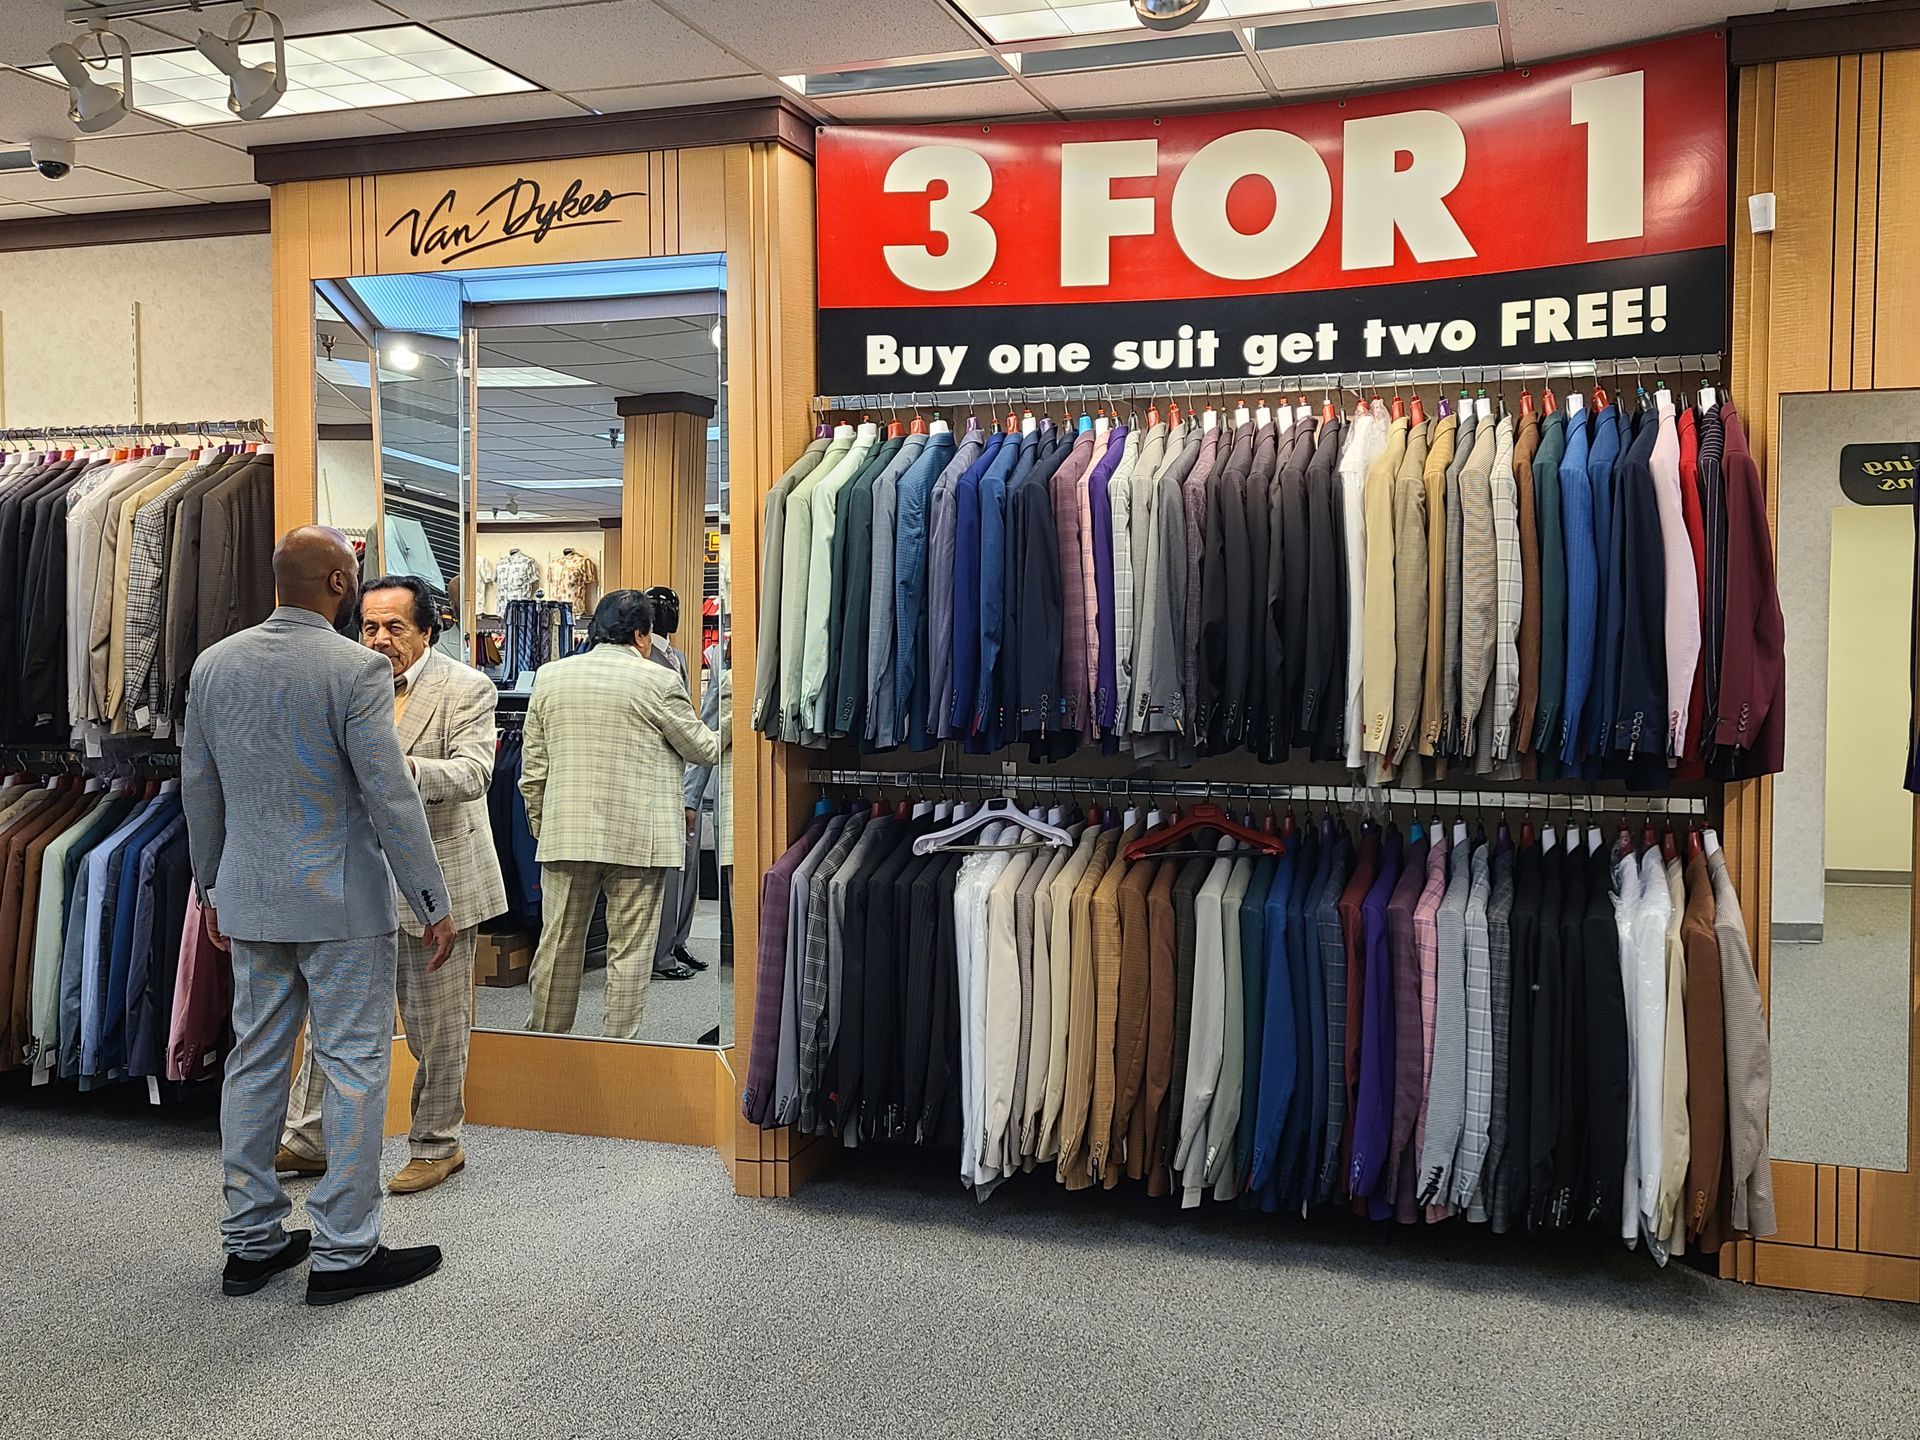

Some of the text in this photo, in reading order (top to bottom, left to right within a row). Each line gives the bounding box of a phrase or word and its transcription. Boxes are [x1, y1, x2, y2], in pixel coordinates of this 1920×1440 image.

[385, 178, 647, 257] Van Dykes
[883, 70, 1644, 292] 3 FOR 1
[866, 285, 1667, 386] Buy one suit get two FREE!
